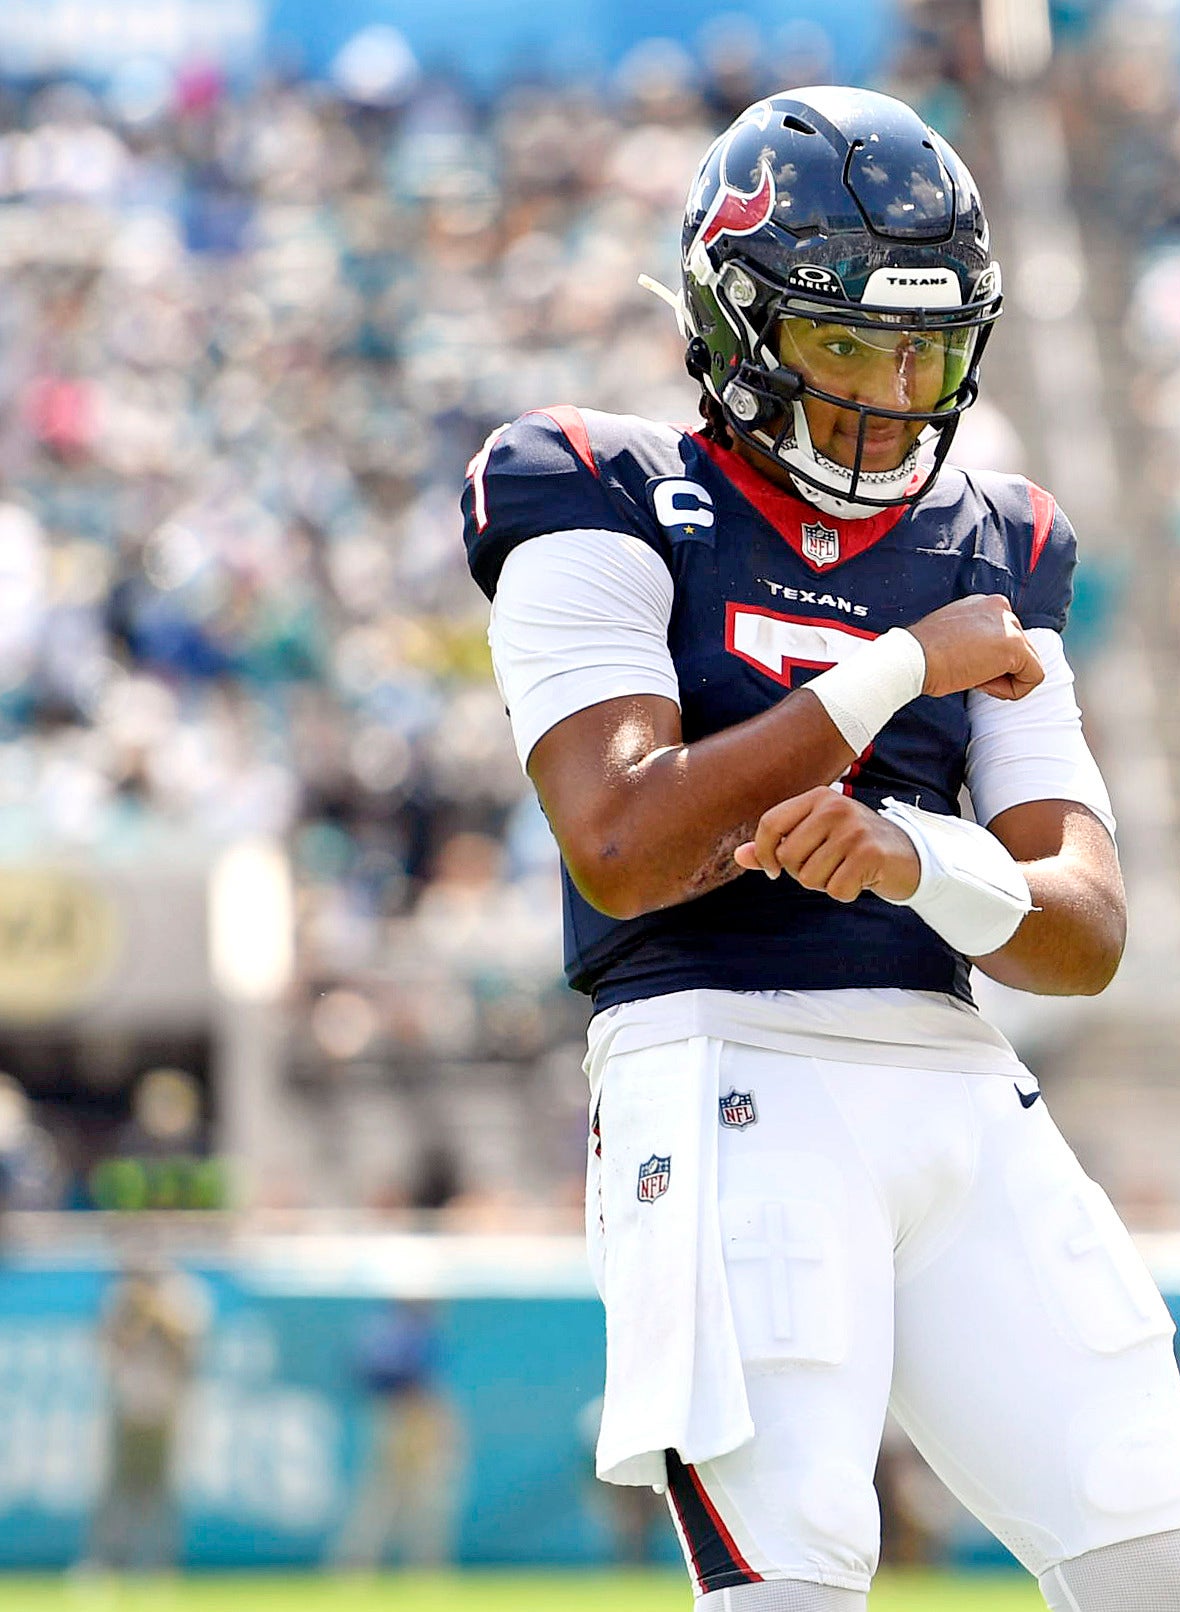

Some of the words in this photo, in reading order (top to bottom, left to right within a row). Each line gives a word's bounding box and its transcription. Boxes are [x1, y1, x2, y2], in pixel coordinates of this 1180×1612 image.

[789, 277, 838, 293] OAKLEY
[886, 277, 948, 286] TEXANS
[652, 479, 714, 528] C
[809, 537, 833, 557] NFL
[763, 579, 869, 617] TEXANS
[724, 1106, 753, 1123] NFL
[641, 1174, 667, 1198] NFL
